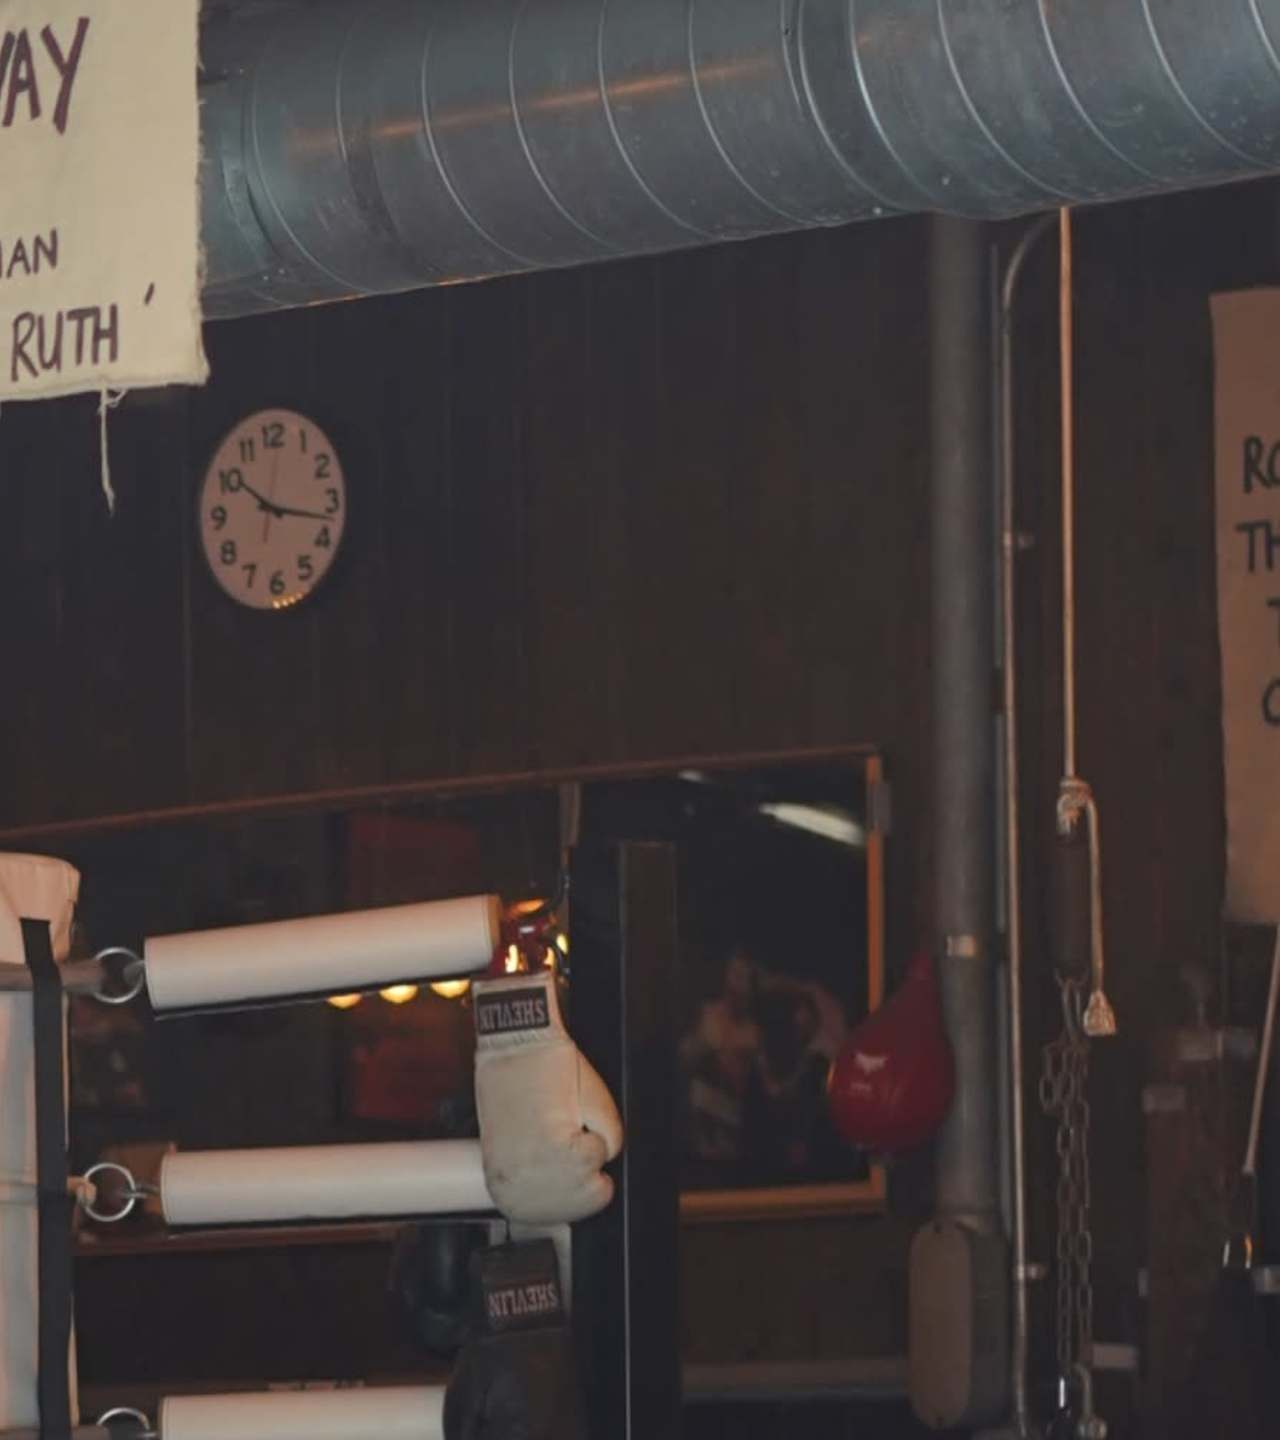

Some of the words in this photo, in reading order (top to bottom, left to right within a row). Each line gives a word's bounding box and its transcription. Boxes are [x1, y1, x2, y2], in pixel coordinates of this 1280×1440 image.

[261, 422, 286, 449] 12
[300, 428, 307, 453] 1
[239, 438, 255, 462] 11
[314, 453, 330, 480] 2
[219, 467, 241, 494] 10
[325, 487, 339, 513] 3
[210, 506, 227, 531] 9
[313, 525, 330, 549] 4
[220, 539, 237, 566] 8
[241, 562, 257, 589] 7
[296, 553, 313, 581] 5
[269, 569, 286, 596] 6
